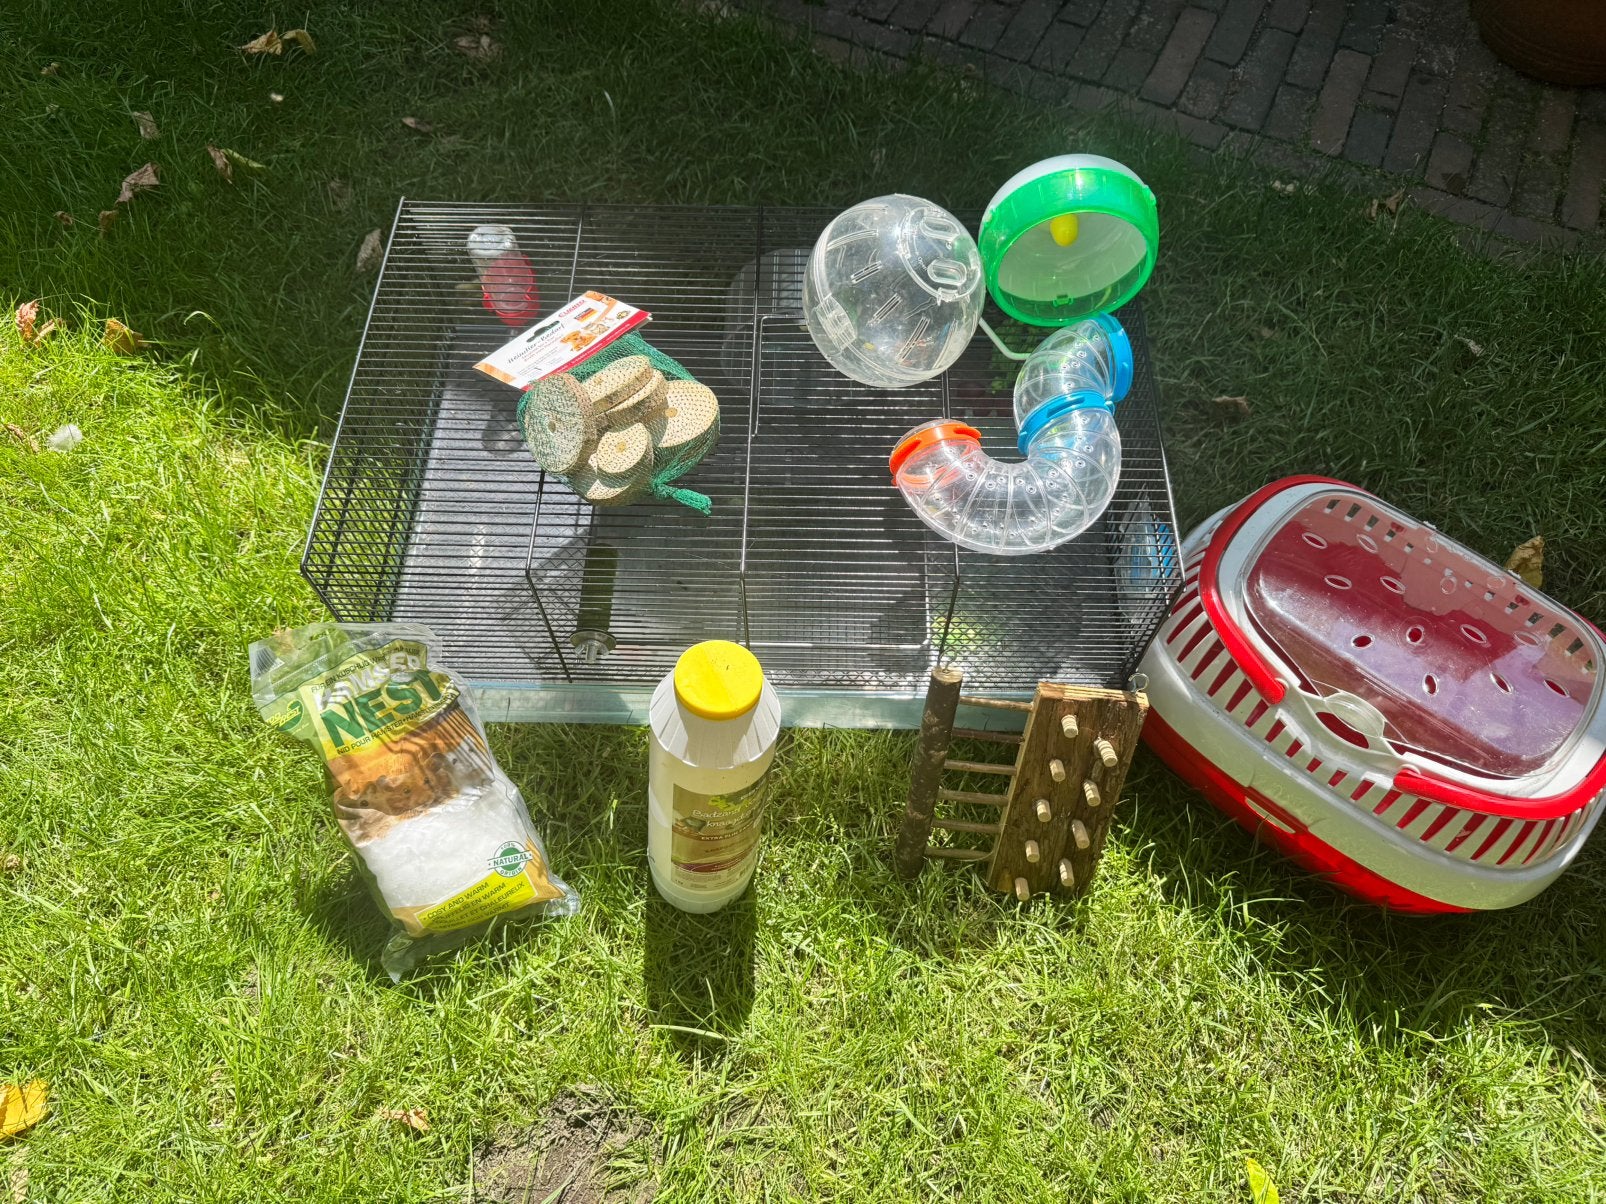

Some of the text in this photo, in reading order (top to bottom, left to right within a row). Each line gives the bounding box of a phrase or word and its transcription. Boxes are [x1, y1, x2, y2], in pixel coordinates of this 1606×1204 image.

[325, 676, 337, 687] EIN
[320, 669, 441, 748] NEST
[337, 719, 403, 755] NID POUR HAMSTER
[493, 853, 529, 867] NATURAL
[500, 866, 522, 876] ORIGIN
[427, 882, 490, 919] COSY AND WARM
[470, 908, 479, 916] ET
[479, 881, 525, 911] CHALEUREUX
[472, 897, 482, 906] EN
[483, 882, 507, 900] WARM
[485, 902, 510, 917] VARMT
